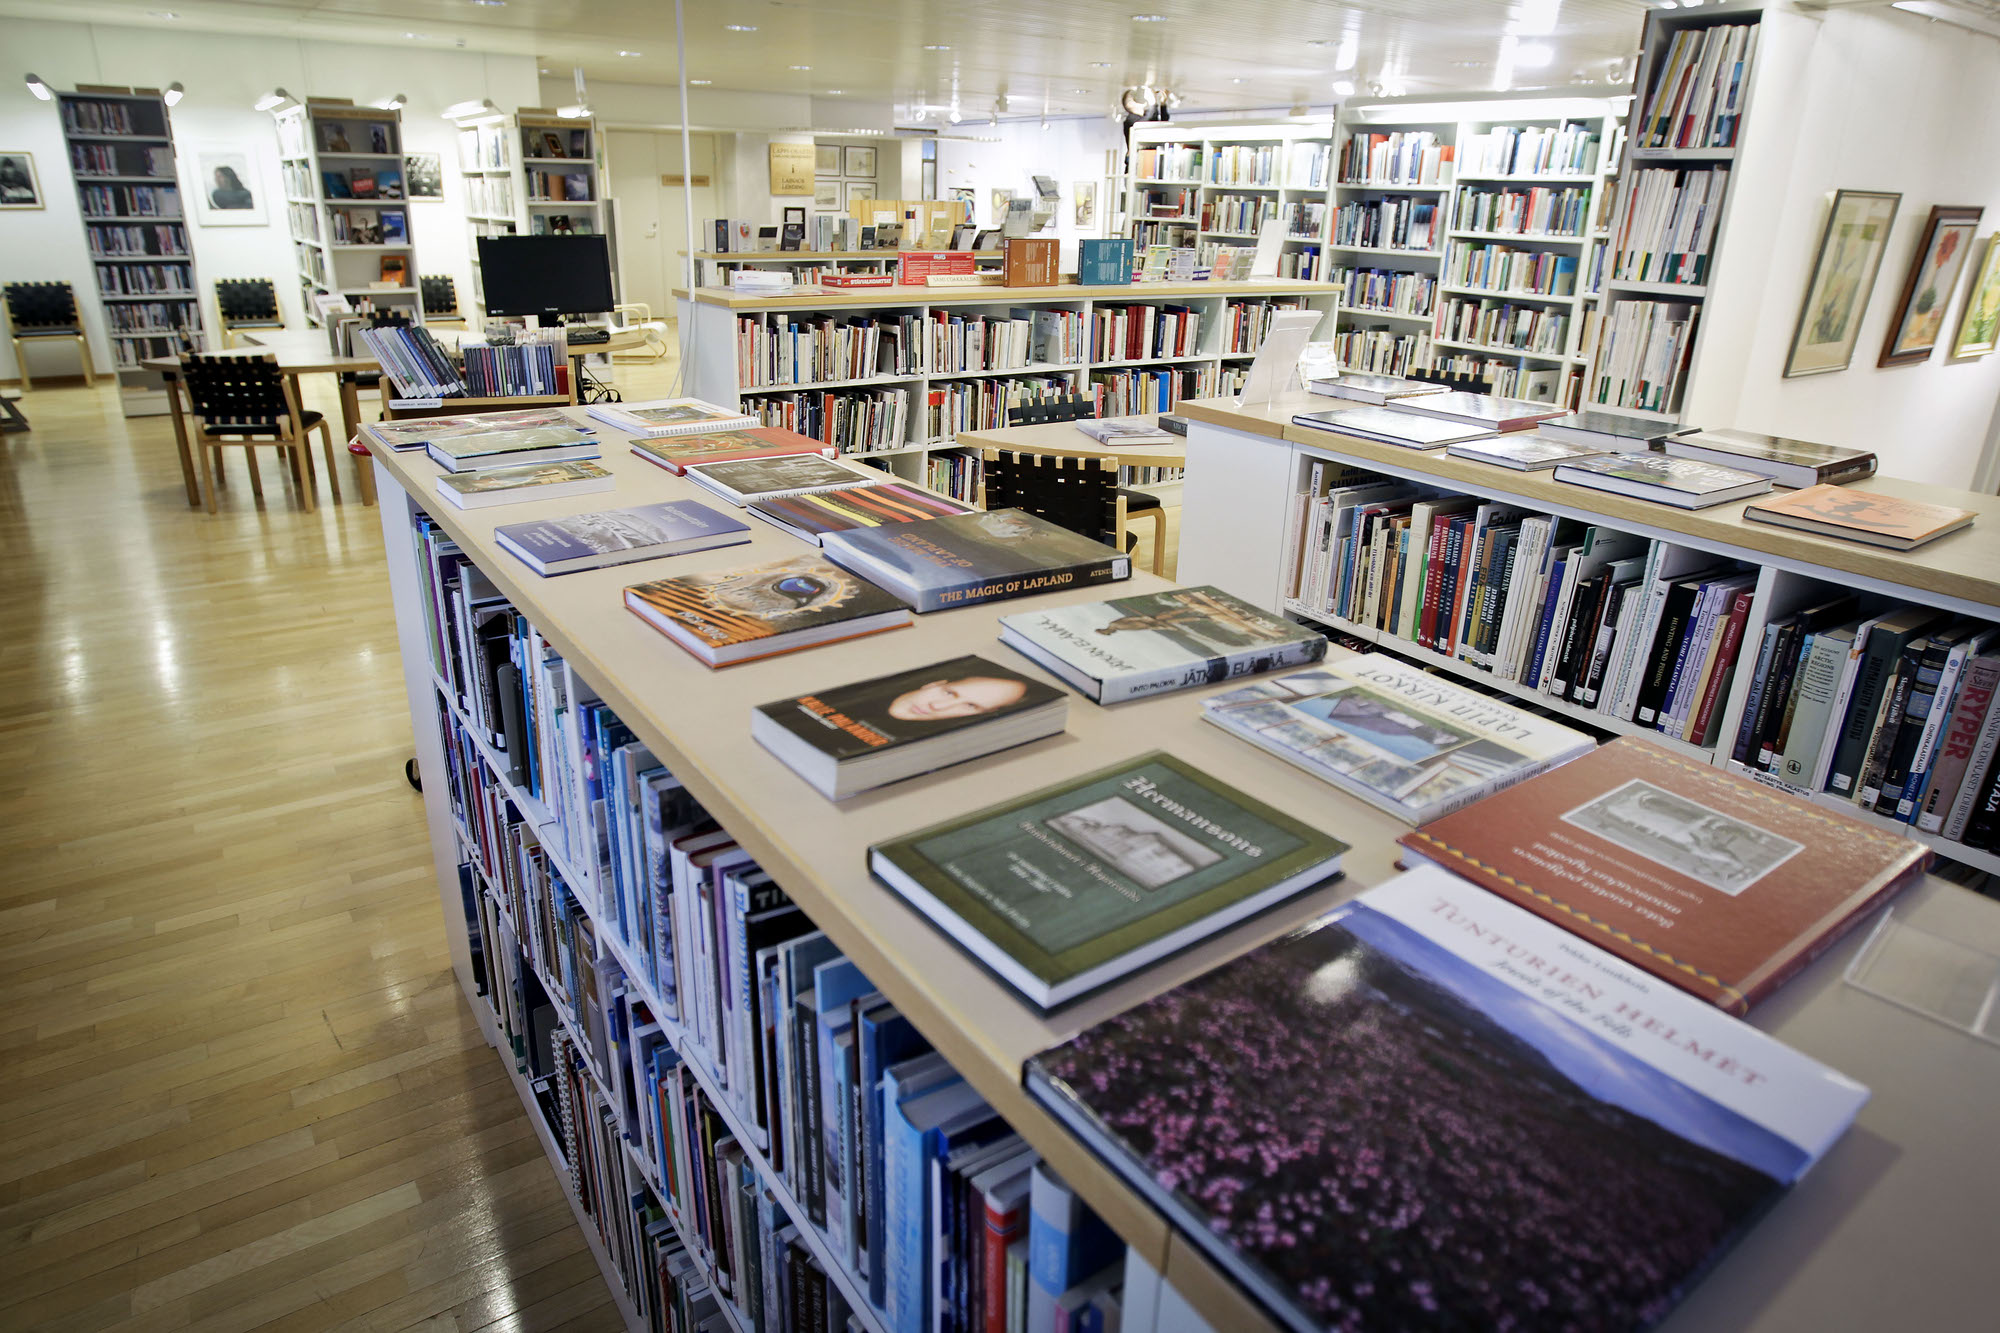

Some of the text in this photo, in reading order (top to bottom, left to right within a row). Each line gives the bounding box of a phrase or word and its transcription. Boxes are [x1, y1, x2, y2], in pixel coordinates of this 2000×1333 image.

[940, 572, 1073, 604] THE MAGIC OF LAPLAND
[1654, 616, 1678, 687] HUNTING AND FISHING
[1810, 659, 1835, 671] REGIONS
[1813, 655, 1834, 665] ARCTIC
[1354, 668, 1449, 706] KIRKOT
[1454, 704, 1532, 741] LAPIN
[1944, 687, 1991, 760] RYPER
[1915, 723, 1936, 773] LOHENKALASTAJAN
[1429, 896, 1768, 1090] TUNTURIEN HELMET
[1561, 992, 1592, 1021] the
